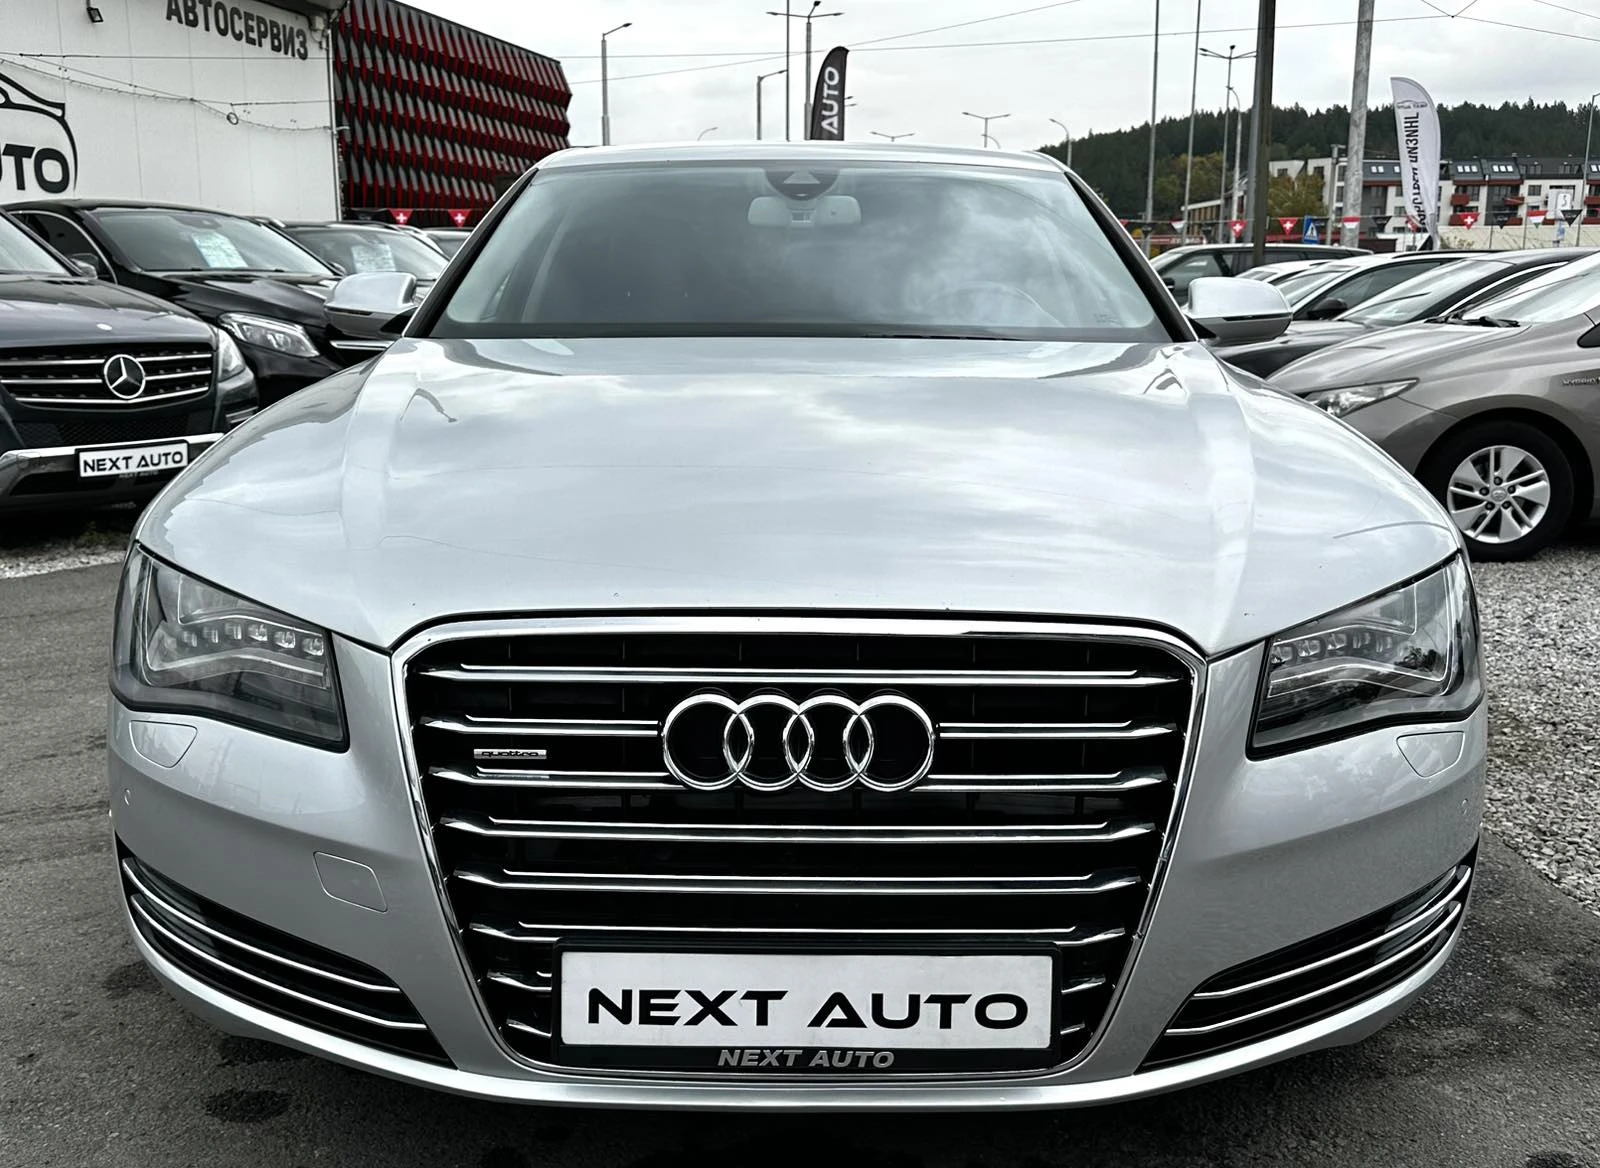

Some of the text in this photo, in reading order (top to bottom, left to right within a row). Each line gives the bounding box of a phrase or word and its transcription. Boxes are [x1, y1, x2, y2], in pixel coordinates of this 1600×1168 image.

[166, 0, 308, 60] АВТОСЕРВИЗ
[821, 66, 839, 135] AUTO
[0, 143, 70, 194] TO
[83, 451, 183, 473] NEXT AUTO
[481, 750, 539, 758] quattro
[588, 987, 1029, 1030] NEXT AUTO
[717, 1049, 895, 1068] NEXT AUTO
